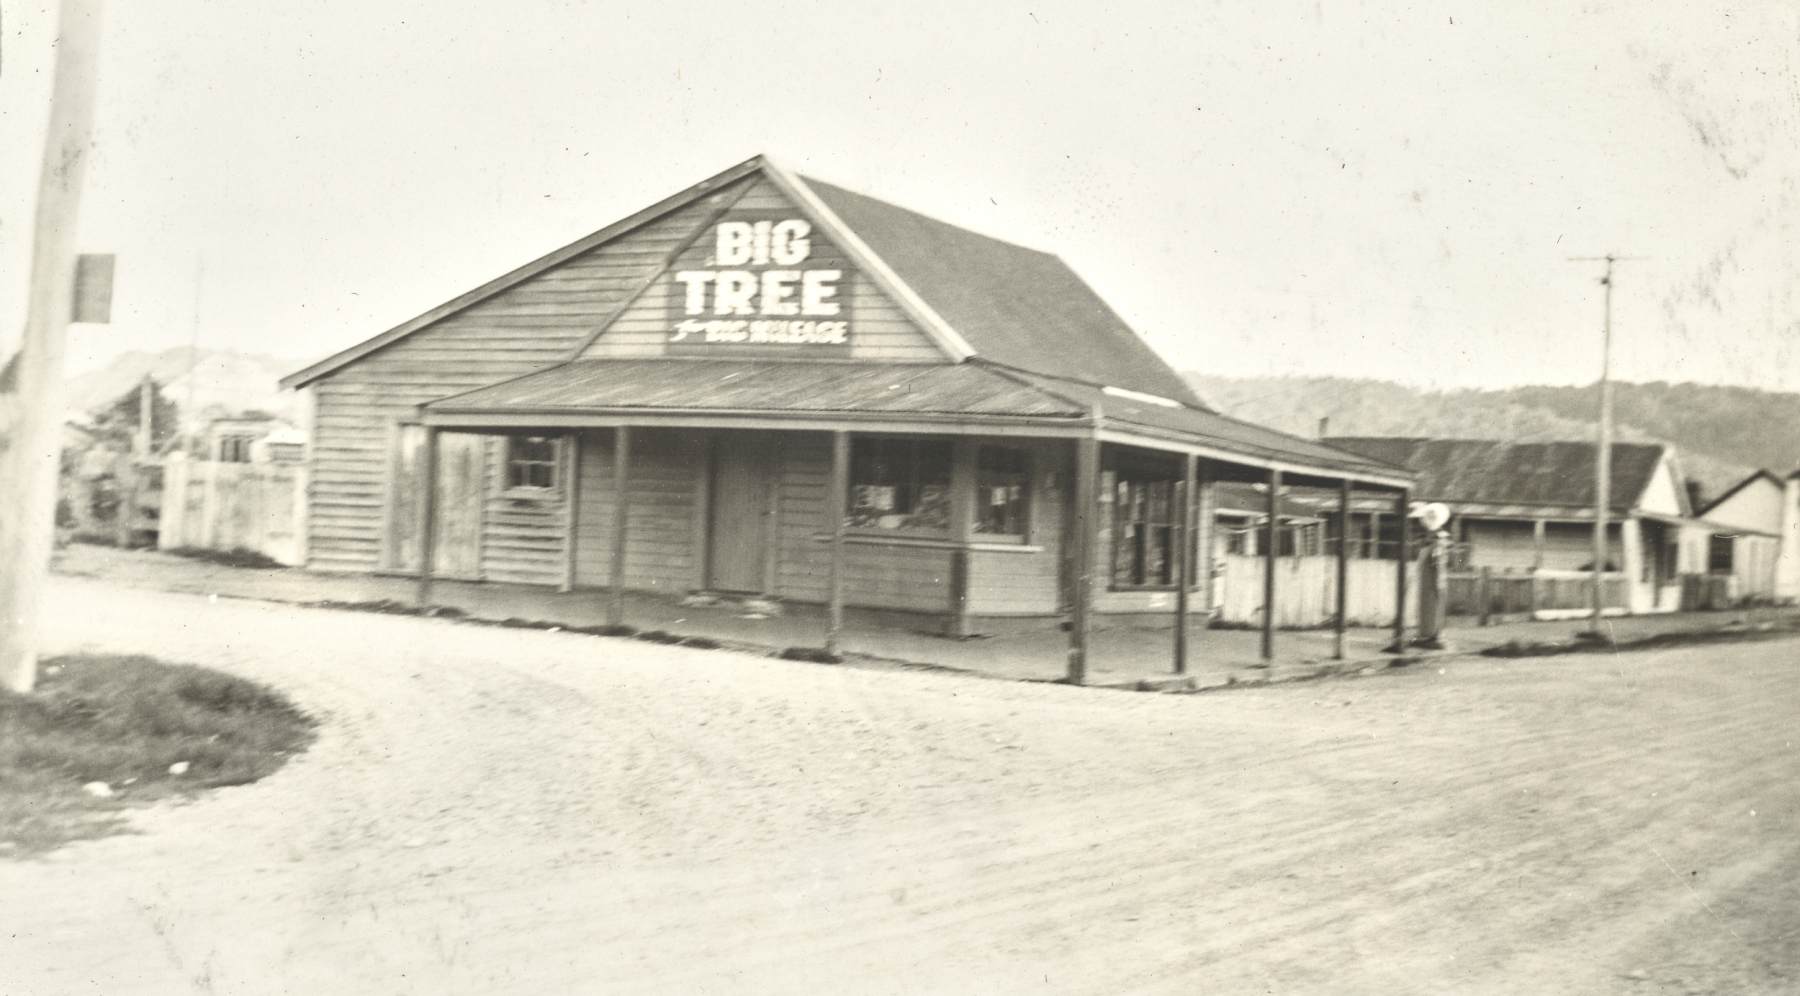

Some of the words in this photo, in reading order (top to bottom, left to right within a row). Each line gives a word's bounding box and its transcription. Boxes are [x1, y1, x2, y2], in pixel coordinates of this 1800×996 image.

[716, 219, 811, 266] BIG
[675, 270, 842, 315] TREE
[705, 320, 749, 342] BIG
[749, 320, 848, 344] MILEAGE
